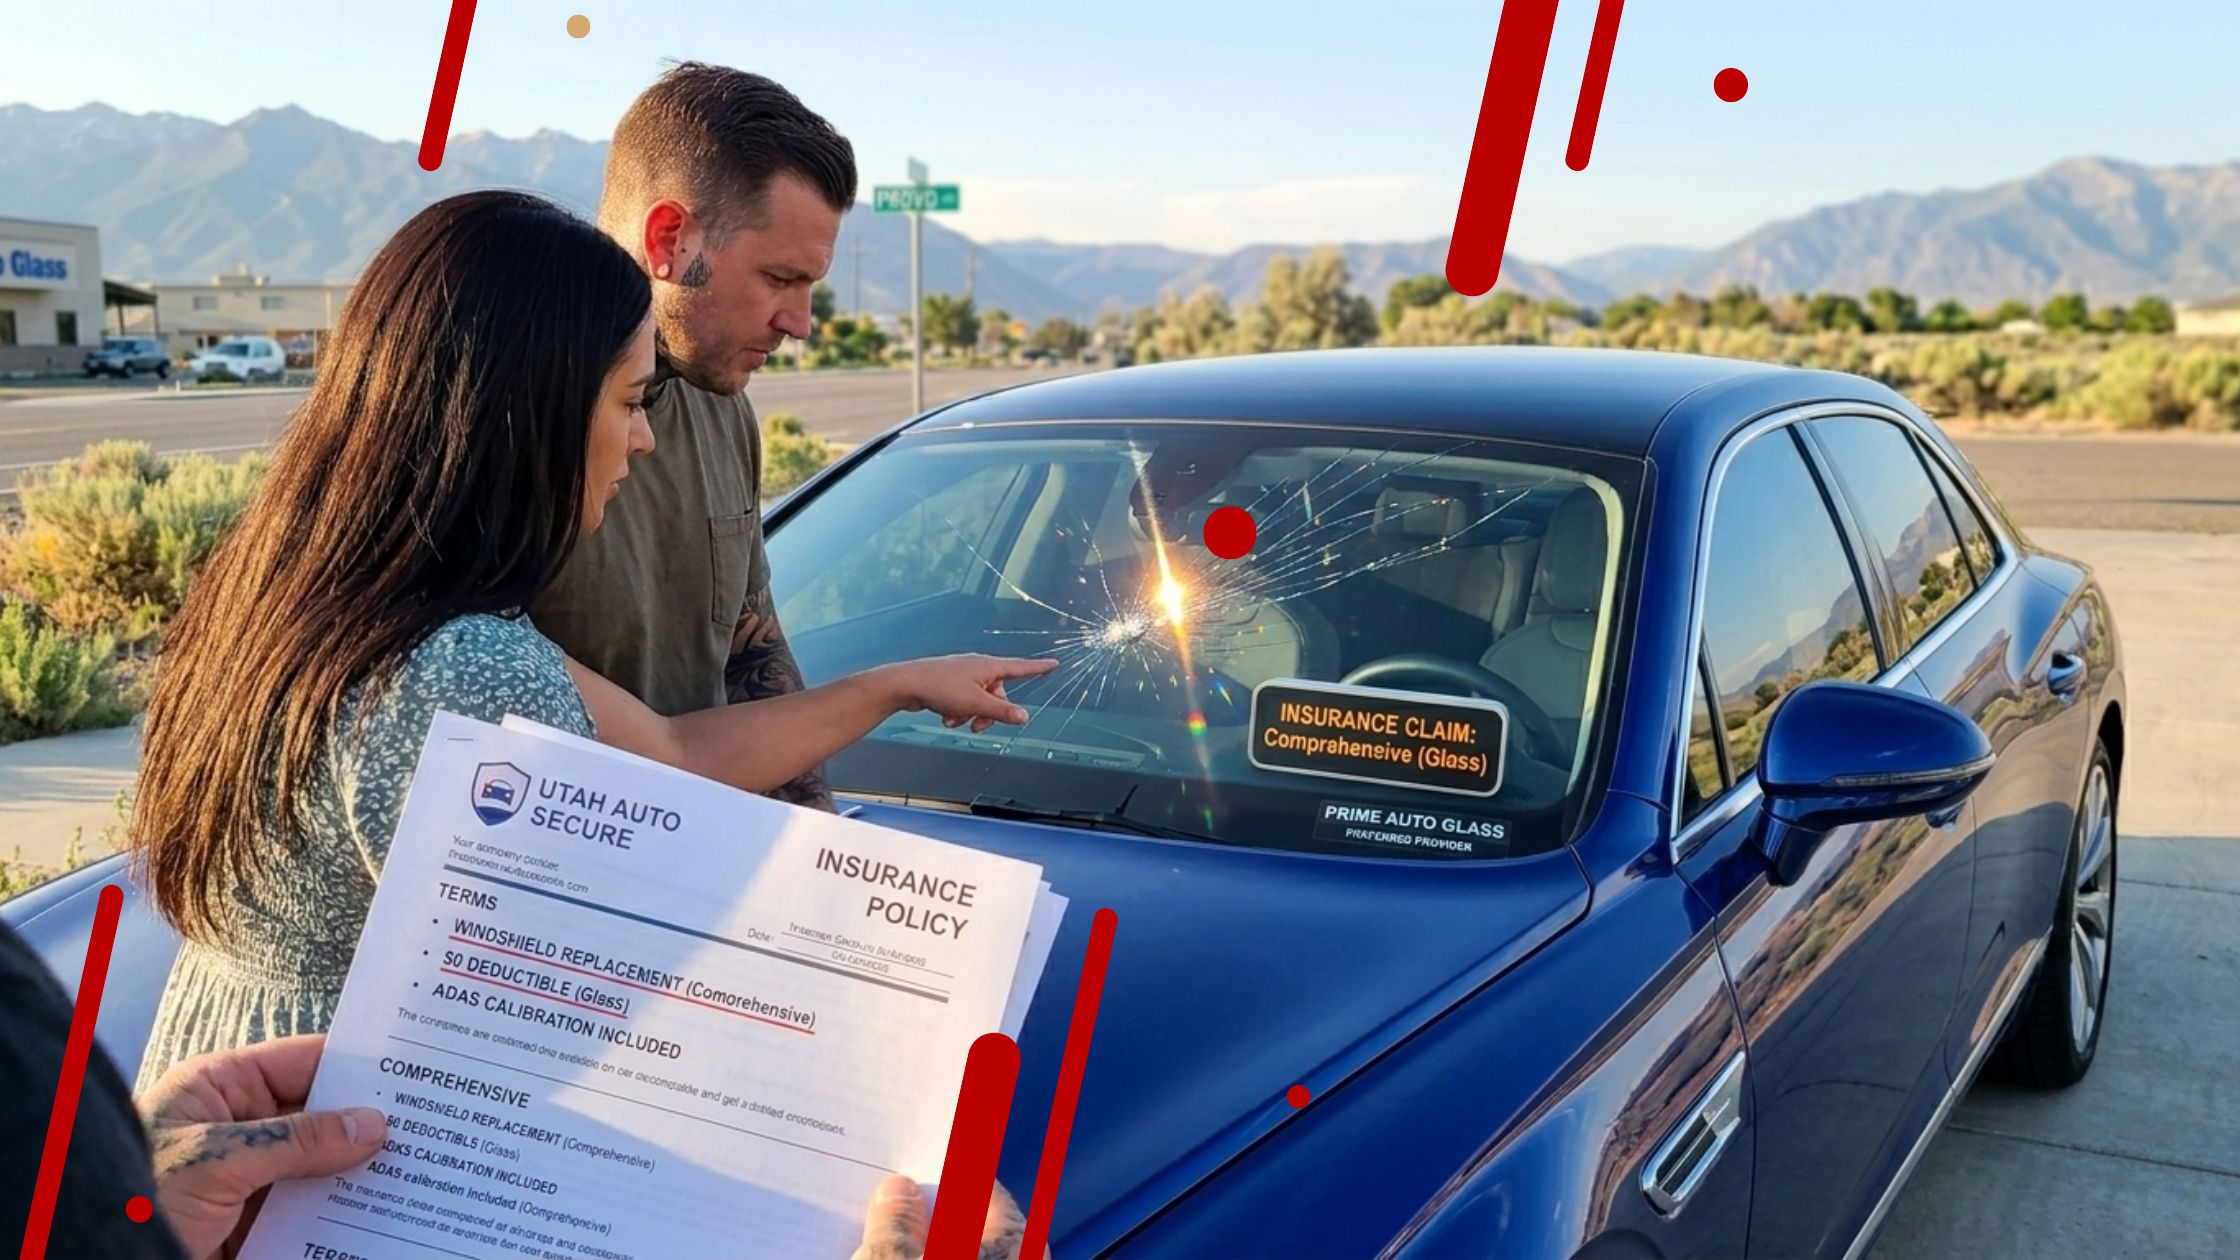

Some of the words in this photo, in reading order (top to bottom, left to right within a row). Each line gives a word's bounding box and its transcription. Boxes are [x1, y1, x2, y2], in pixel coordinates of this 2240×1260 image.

[11, 249, 67, 280] Glass
[1280, 702, 1399, 735] INSURANCE
[1405, 716, 1476, 744] CLAIM:
[1418, 745, 1488, 777] (Glass)
[538, 777, 607, 813] UTAH
[611, 802, 682, 832] AUTO
[1324, 805, 1382, 824] PRIME
[1385, 812, 1437, 830] AUTO
[1441, 818, 1505, 839] GLASS
[530, 806, 635, 850] SECURE
[439, 882, 498, 911] TERMS
[815, 847, 977, 908] INSURANCE
[866, 895, 969, 940] POLICY
[454, 918, 556, 958] WINDSHIELD
[560, 946, 684, 993] REPLACEMENT
[466, 956, 572, 997] DEDUCTIBLE
[432, 983, 481, 1006] ADAS
[484, 996, 595, 1038] CALIBRATION
[597, 1025, 682, 1060] INCLUDED
[380, 1057, 532, 1109] COMPREHENSIVE
[494, 1169, 558, 1195] INCLUDED
